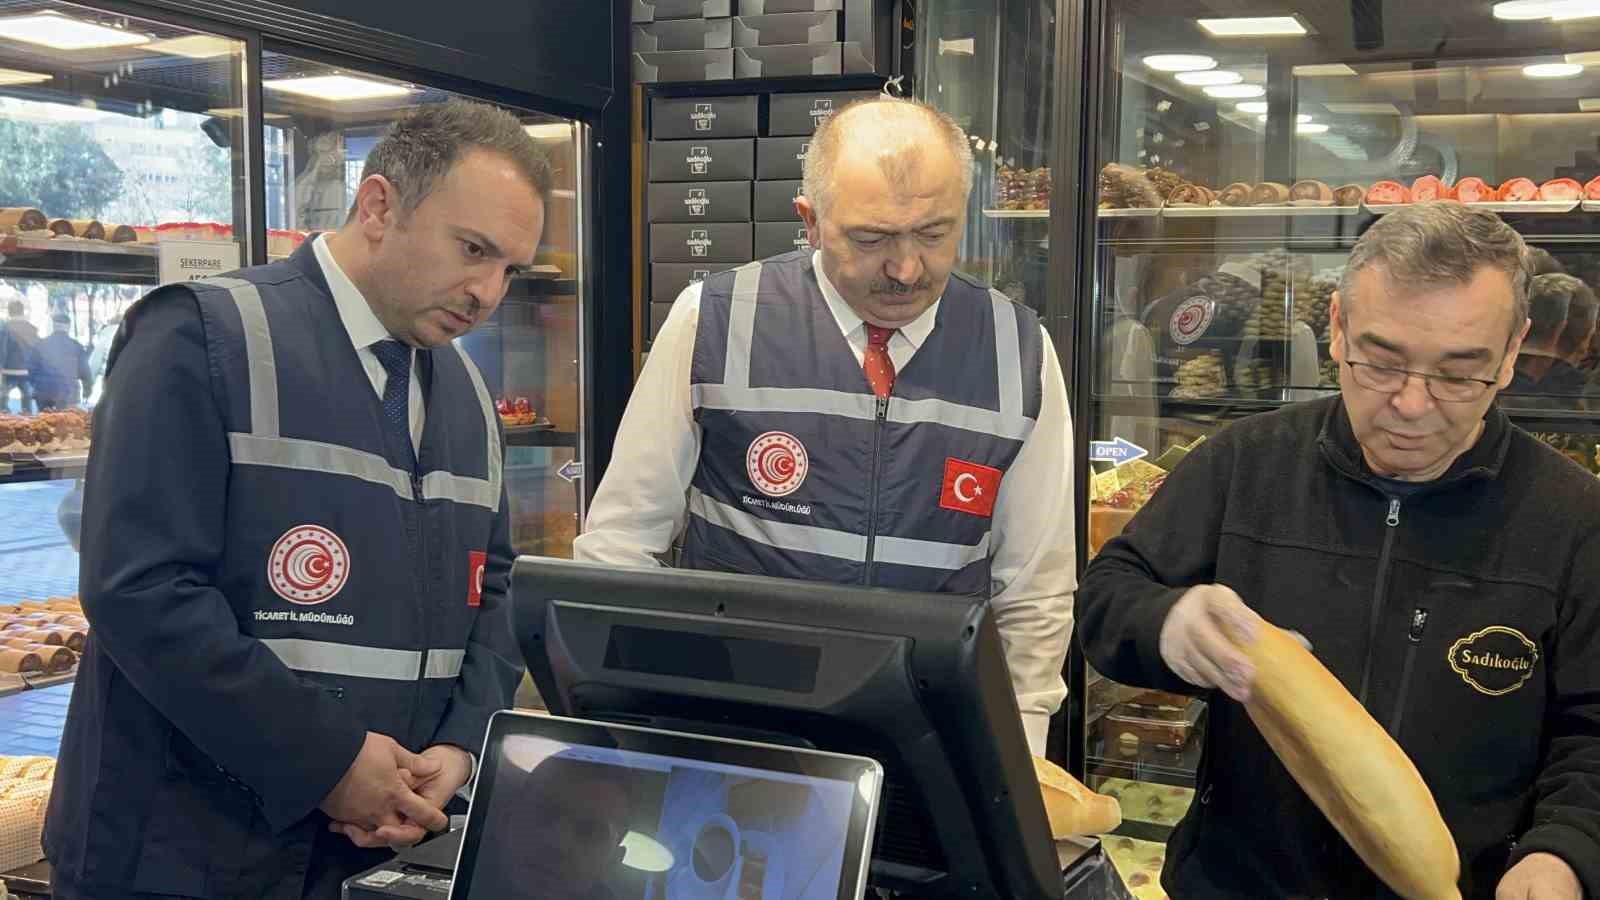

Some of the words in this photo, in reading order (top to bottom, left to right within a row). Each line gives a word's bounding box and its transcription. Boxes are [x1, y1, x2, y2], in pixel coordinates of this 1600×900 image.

[1096, 446, 1128, 457] OPEN
[253, 610, 289, 620] TİCARET
[290, 610, 299, 621] İL
[299, 611, 354, 625] MÜDÜRLÜĞÜ
[1462, 649, 1529, 670] Sadıkoğlu
